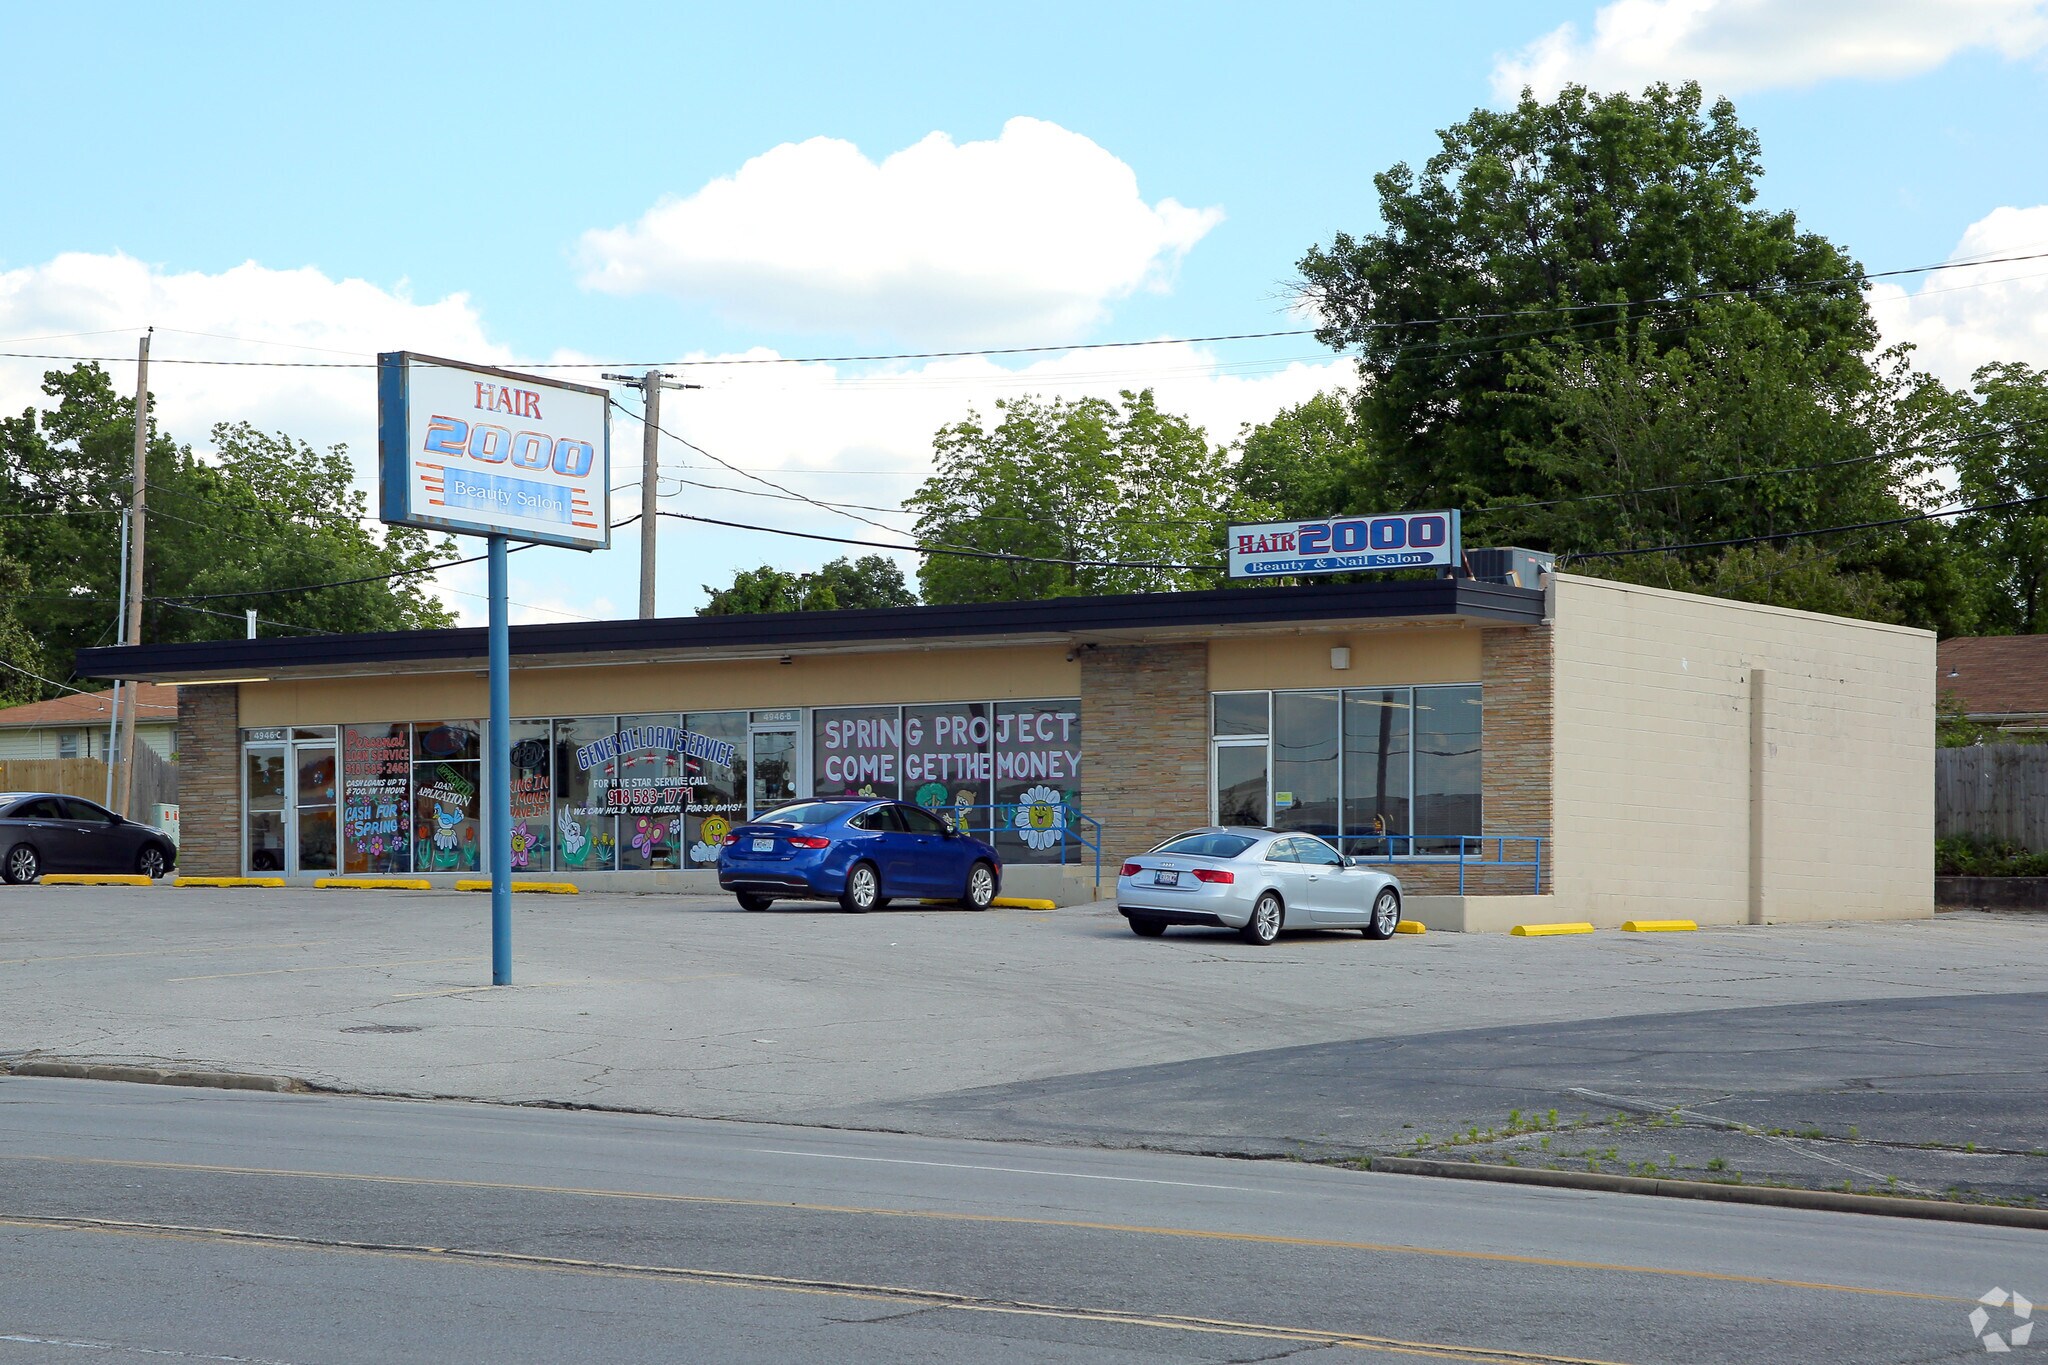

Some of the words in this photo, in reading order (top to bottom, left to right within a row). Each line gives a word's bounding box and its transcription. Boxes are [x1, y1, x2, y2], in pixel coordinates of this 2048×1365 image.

[473, 381, 543, 420] HAIR
[423, 414, 594, 479] 2000
[453, 481, 512, 506] Beauty
[516, 491, 563, 511] Salon
[1237, 532, 1296, 555] HAIR
[1298, 515, 1446, 556] 2000
[1252, 561, 1306, 573] Beauty
[1313, 558, 1327, 569] &
[1336, 556, 1369, 567] Nail
[1376, 553, 1422, 565] Salon
[346, 729, 405, 751] Personal
[824, 716, 924, 750] SPRING
[935, 711, 1078, 747] PROJECT
[345, 750, 369, 761] LOAN
[371, 749, 409, 761] SERVICE
[576, 729, 639, 771] GENERAL
[637, 725, 677, 749] LOAN
[676, 729, 735, 769] SERVICE
[345, 763, 361, 775] 918
[824, 754, 896, 784] COME
[905, 753, 952, 782] GET
[953, 751, 991, 781] THE
[996, 749, 1082, 781] MONEY
[364, 779, 386, 787] LOANS
[398, 778, 407, 786] TO
[368, 787, 377, 795] IN
[385, 787, 405, 795] HOUR
[434, 781, 455, 791] LOAN
[533, 774, 549, 791] IN
[593, 779, 609, 788] FOR
[611, 778, 630, 788] FIVE
[632, 778, 652, 787] STAR
[655, 777, 688, 787] SERVICE
[689, 776, 708, 786] CALL
[417, 787, 473, 807] APPLICATION
[608, 788, 631, 806] 918
[633, 787, 694, 805] 583-1771
[344, 806, 371, 822] CASH
[376, 804, 398, 819] FOR
[573, 807, 586, 816] WE
[587, 807, 604, 815] CAN
[630, 805, 651, 814] YOUR
[653, 805, 681, 813] CHECK
[685, 804, 702, 813] FOR
[703, 804, 714, 812] 30
[715, 803, 742, 812] DAYS!
[354, 819, 398, 837] SPRING
